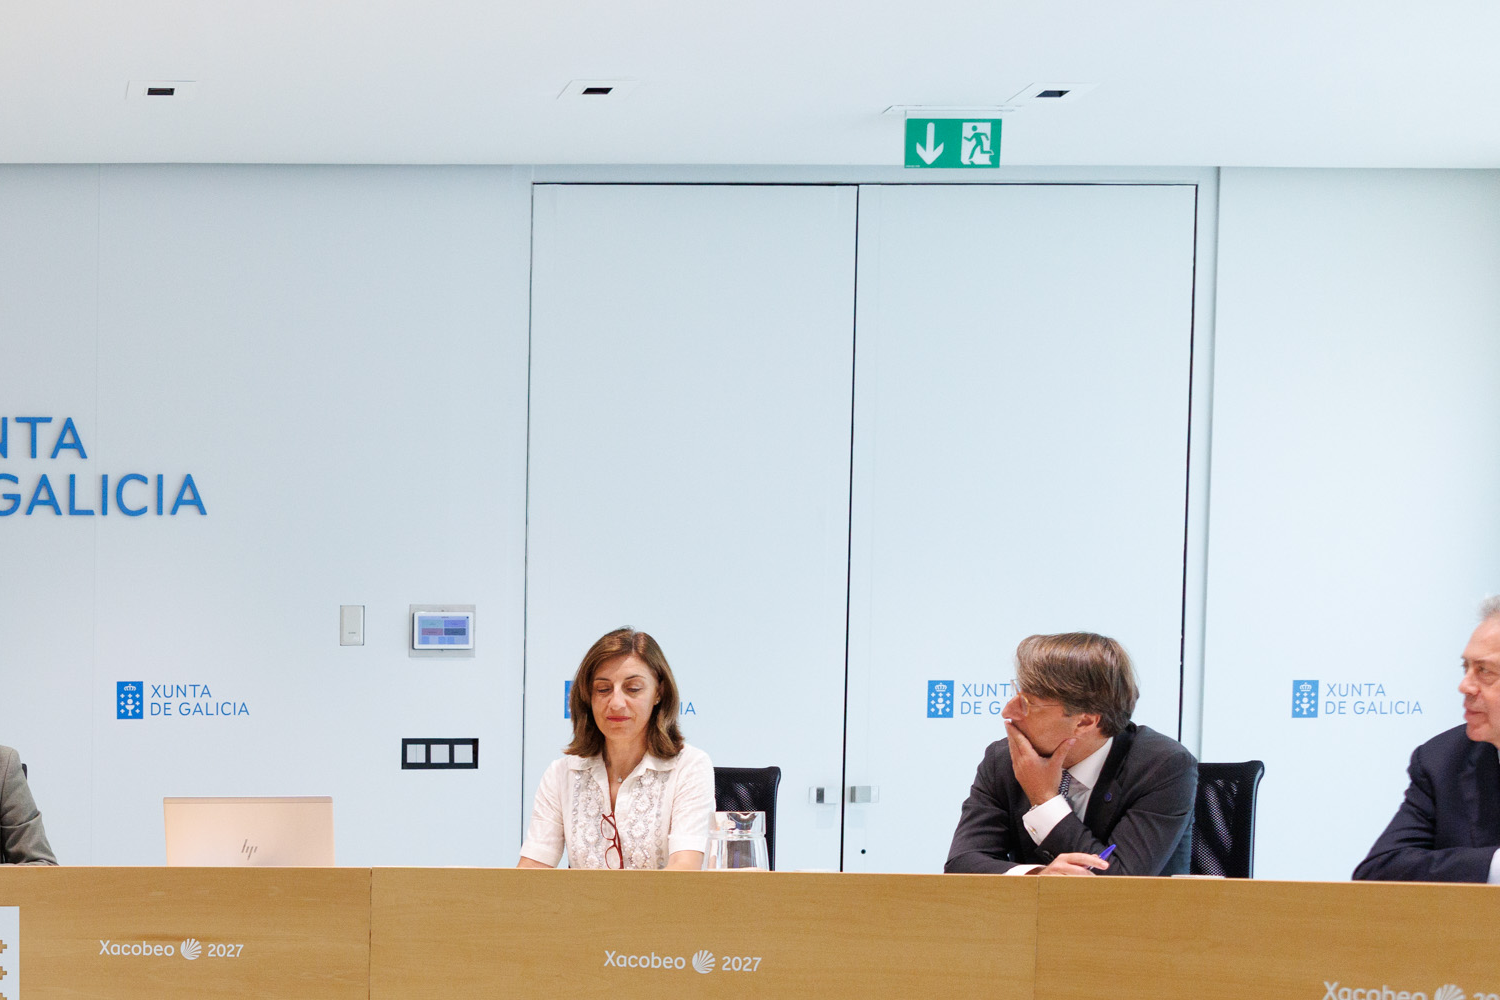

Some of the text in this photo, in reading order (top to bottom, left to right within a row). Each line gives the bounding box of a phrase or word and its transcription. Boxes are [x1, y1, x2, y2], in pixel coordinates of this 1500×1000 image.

[151, 684, 212, 698] XUNTA
[961, 683, 1013, 698] XUNT
[1326, 683, 1387, 697] XUNTA
[150, 701, 250, 716] DE GALICIA
[960, 701, 982, 715] DE
[1325, 700, 1423, 715] DE GALICIA
[241, 838, 258, 861] hp
[99, 939, 244, 958] Xacobeo 2027
[603, 950, 762, 972] Xacobeo 2027
